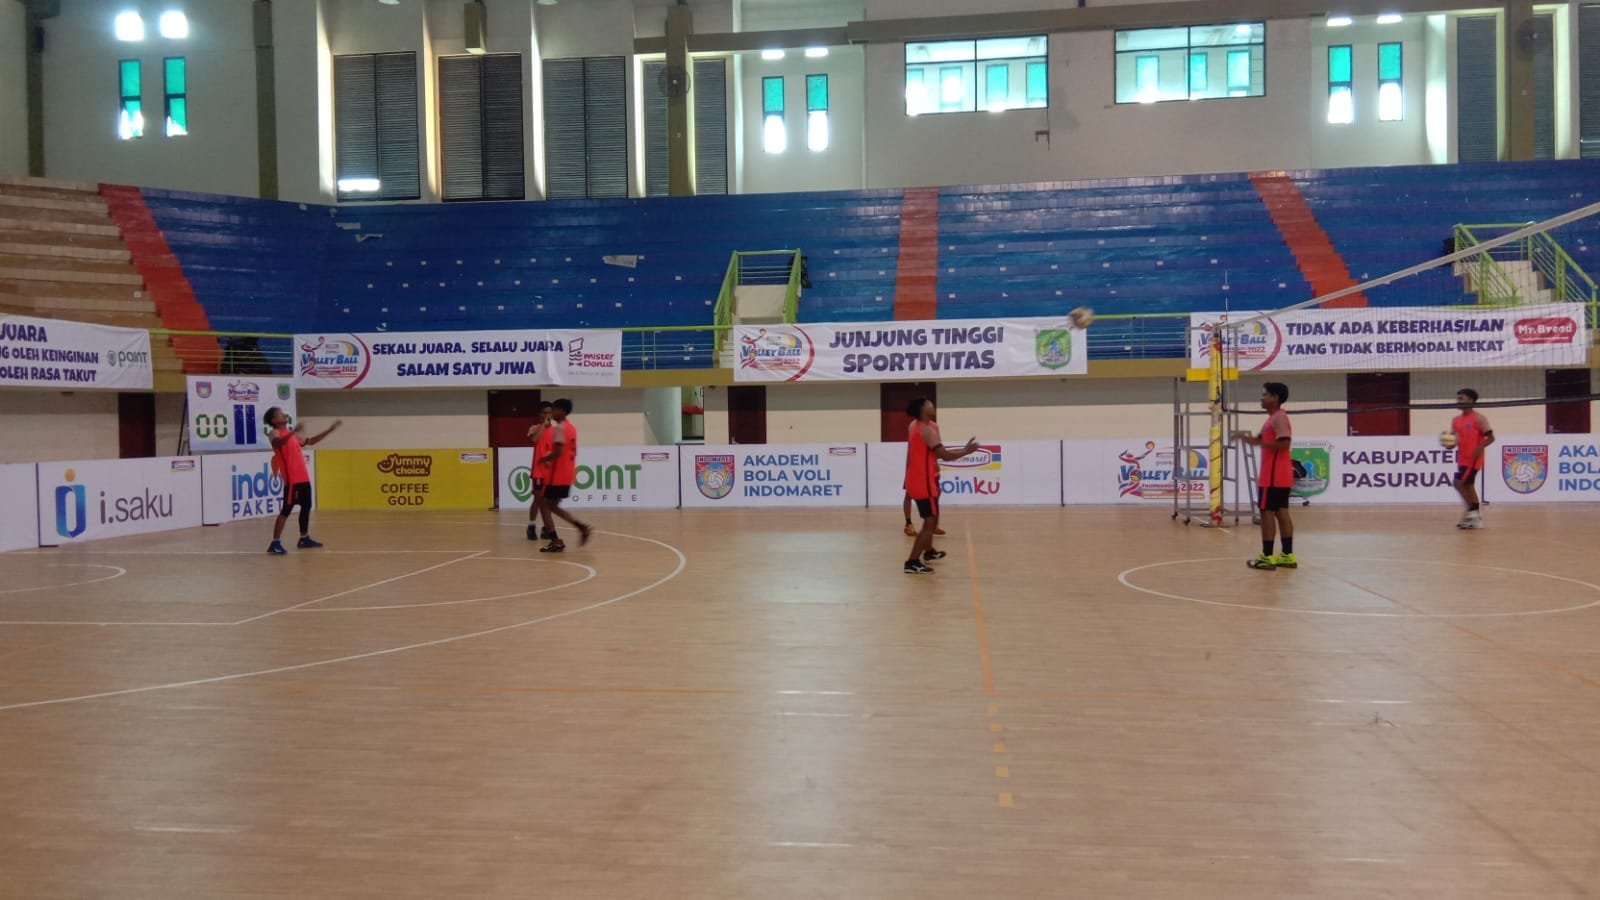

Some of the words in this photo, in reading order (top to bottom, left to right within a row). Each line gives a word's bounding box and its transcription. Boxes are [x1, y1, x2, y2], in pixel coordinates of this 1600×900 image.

[0, 322, 48, 343] JUARA
[1286, 322, 1335, 336] TIDAK
[1339, 322, 1374, 335] ADA
[1376, 319, 1504, 334] KEBERHASILAN
[829, 329, 928, 348] JUNJUNG
[932, 326, 1004, 345] TINGGI
[12, 347, 39, 361] OLEH
[41, 348, 99, 364] KEINGINAN
[373, 343, 416, 355] SEKALI
[471, 341, 517, 353] SELALU
[520, 340, 564, 353] JUARA
[1287, 343, 1327, 356] YANG
[1330, 342, 1373, 355] TIDAK
[1376, 341, 1454, 354] BERMODAL
[1457, 340, 1505, 353] NEKAT
[397, 363, 449, 377] SALAM
[453, 362, 492, 376] SATU
[495, 361, 536, 376] JIWA
[843, 350, 995, 373] SPORTIVITAS
[0, 366, 28, 380] OLEH
[31, 367, 60, 381] RASA
[63, 369, 97, 383] TAKUT
[743, 455, 819, 467] AKADEMI
[1342, 451, 1459, 464] KABUPATE
[573, 464, 642, 490] OINT
[744, 470, 789, 482] BOLA
[793, 469, 831, 481] VOLI
[1342, 473, 1454, 488] PASURUA
[381, 484, 429, 494] COFFEE
[744, 485, 843, 497] INDOMARET
[940, 477, 1000, 494] oinku
[100, 487, 173, 525] i.saku
[388, 496, 424, 506] GOLD
